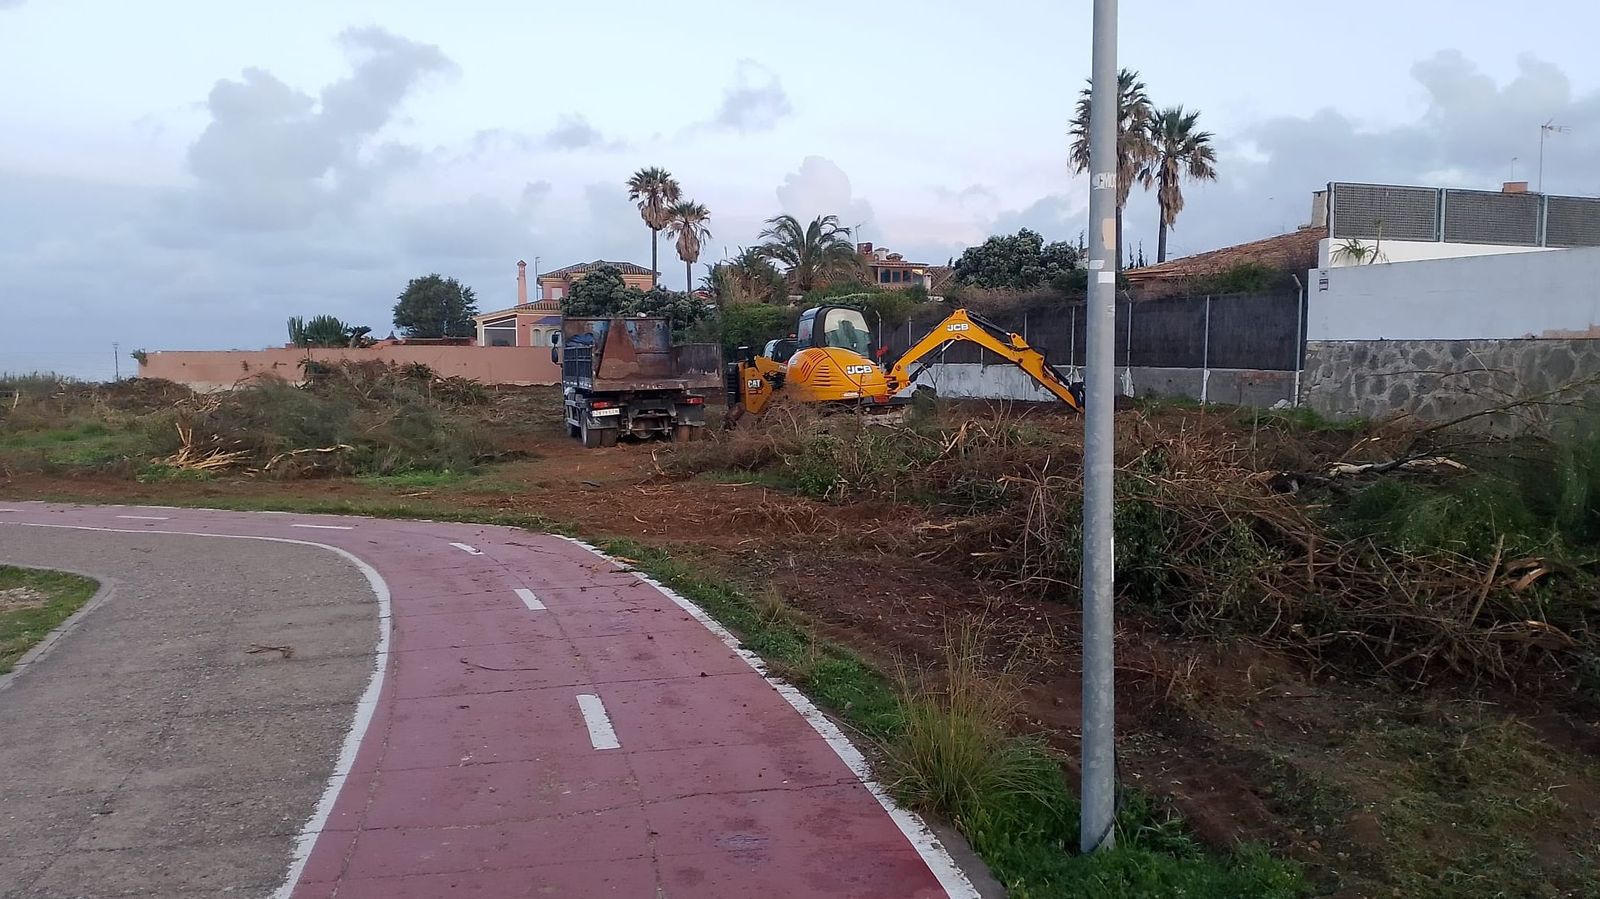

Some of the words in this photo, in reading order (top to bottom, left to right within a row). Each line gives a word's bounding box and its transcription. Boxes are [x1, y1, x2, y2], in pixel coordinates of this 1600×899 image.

[946, 323, 969, 332] JCB
[846, 365, 873, 375] JCB
[747, 379, 761, 388] CAT
